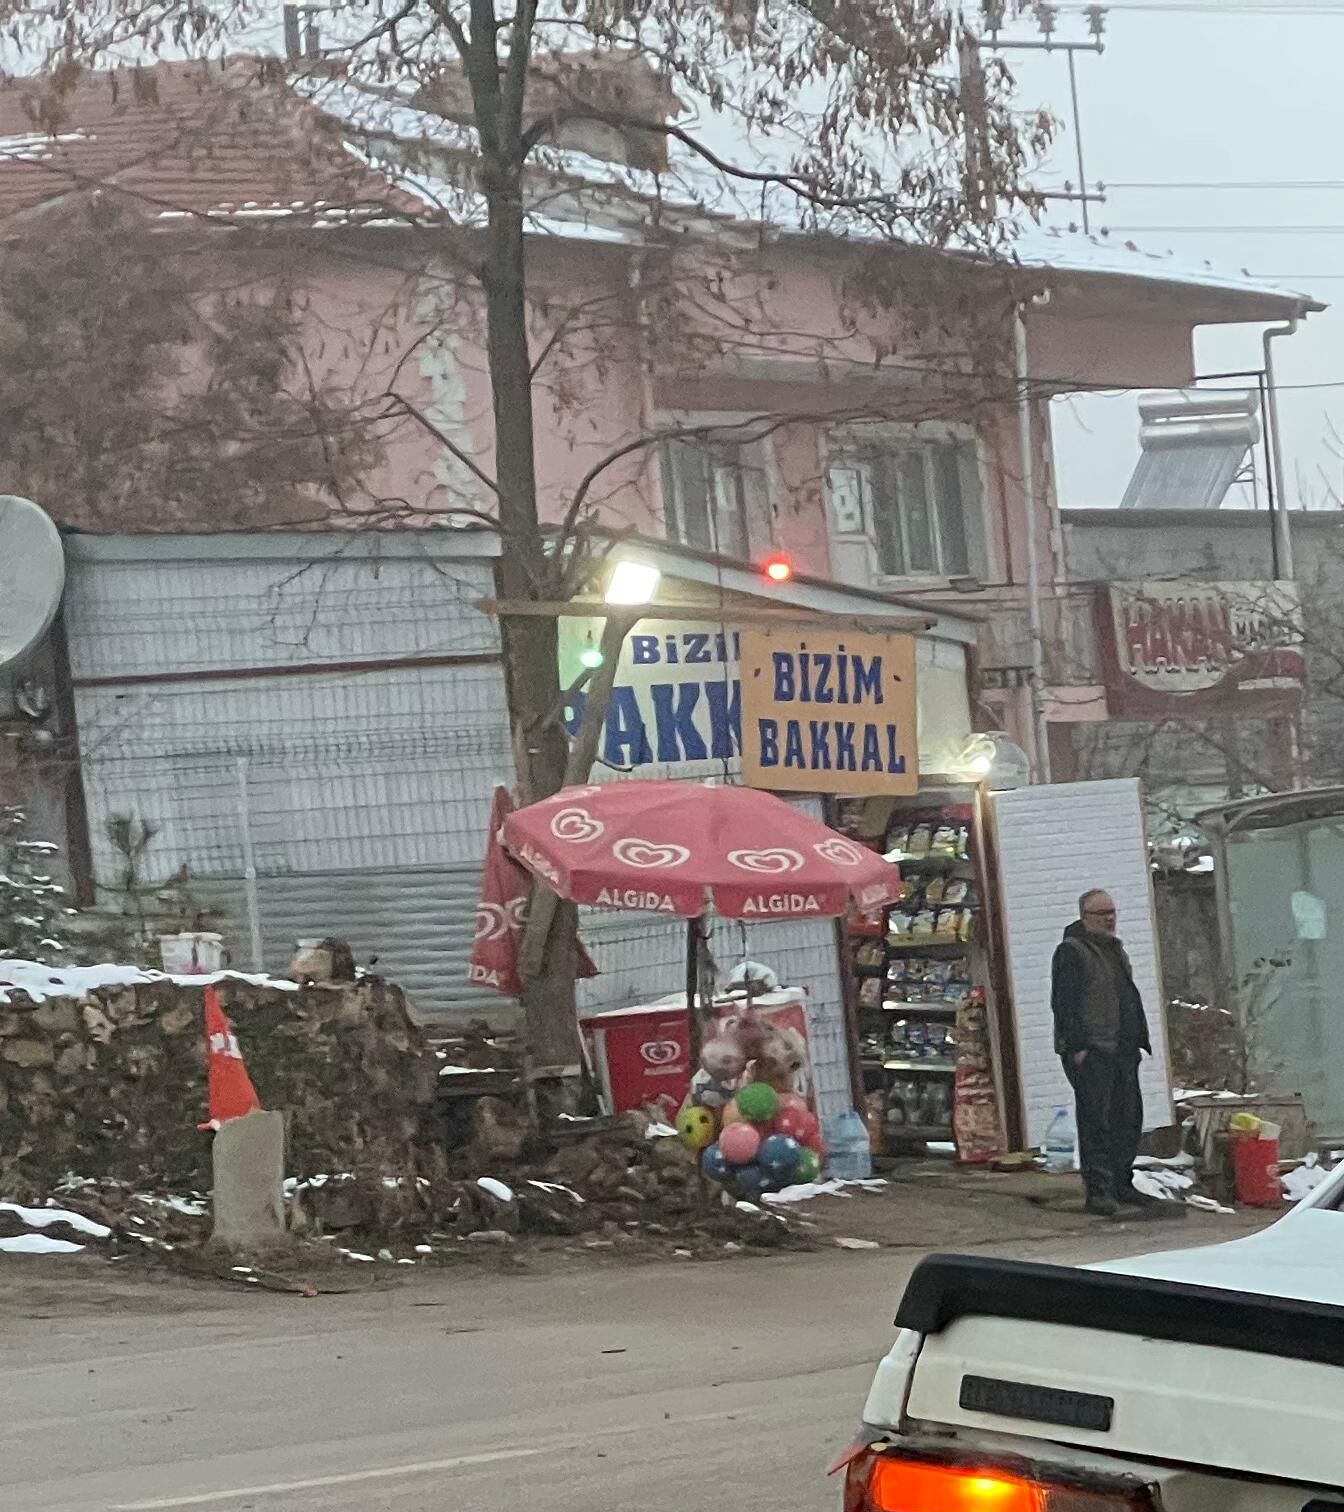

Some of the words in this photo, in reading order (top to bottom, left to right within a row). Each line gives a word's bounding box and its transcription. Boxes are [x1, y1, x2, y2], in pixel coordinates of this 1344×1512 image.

[631, 632, 740, 664] BiZi
[773, 643, 884, 704] BİZİM
[758, 719, 906, 773] BAKKAL
